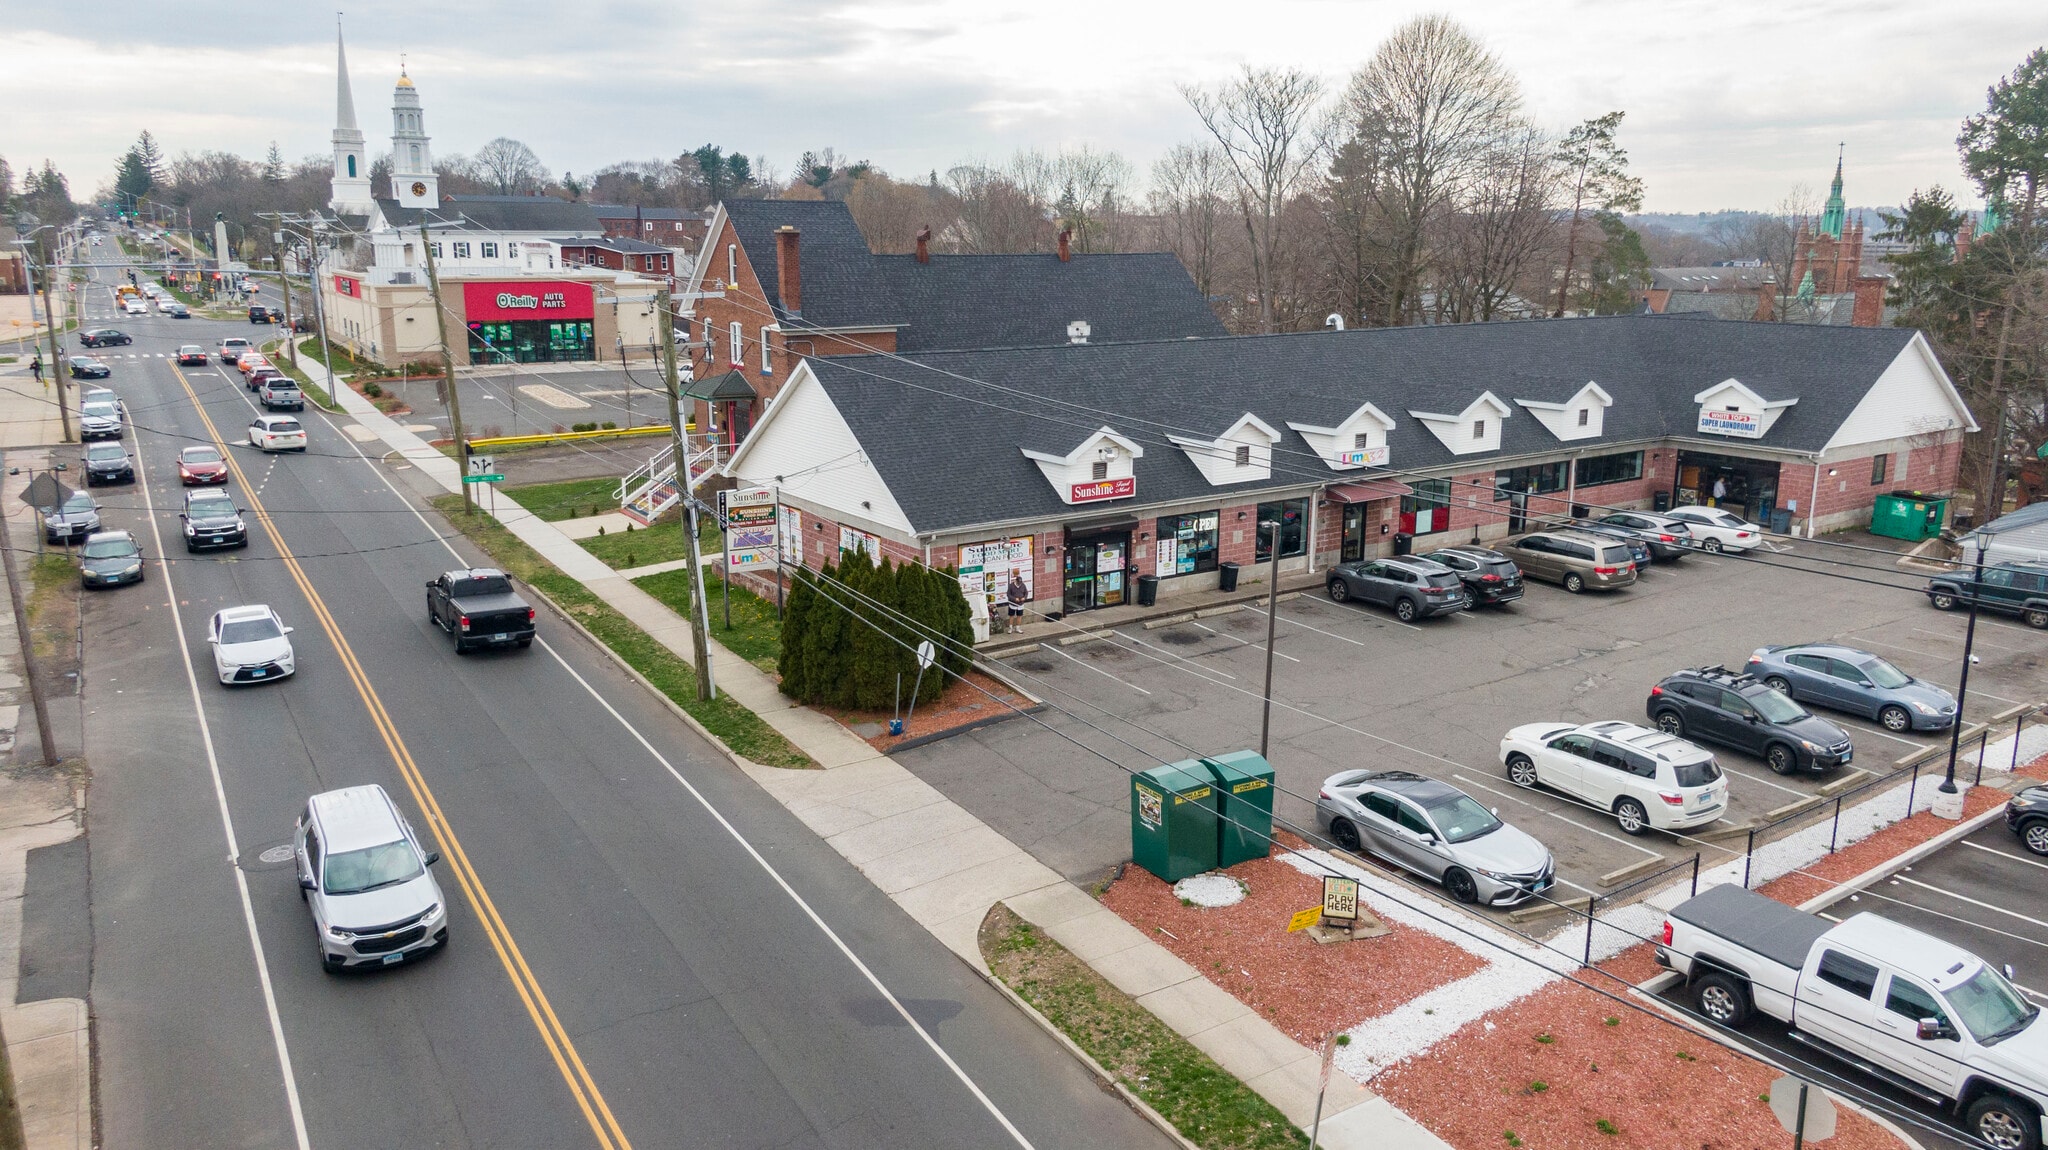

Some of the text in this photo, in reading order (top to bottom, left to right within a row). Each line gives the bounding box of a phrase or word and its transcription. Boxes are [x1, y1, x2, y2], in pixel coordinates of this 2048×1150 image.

[497, 293, 564, 309] O'Reilly AUTO
[542, 300, 567, 308] PARTS
[1701, 418, 1718, 428] SUPER
[1719, 420, 1757, 432] LAUNDROMAT
[733, 492, 771, 502] Sunshine
[1075, 484, 1114, 498] Sunshine
[1193, 516, 1218, 531] OPEN
[1327, 893, 1354, 904] PLAY
[1327, 902, 1353, 912] HERE
